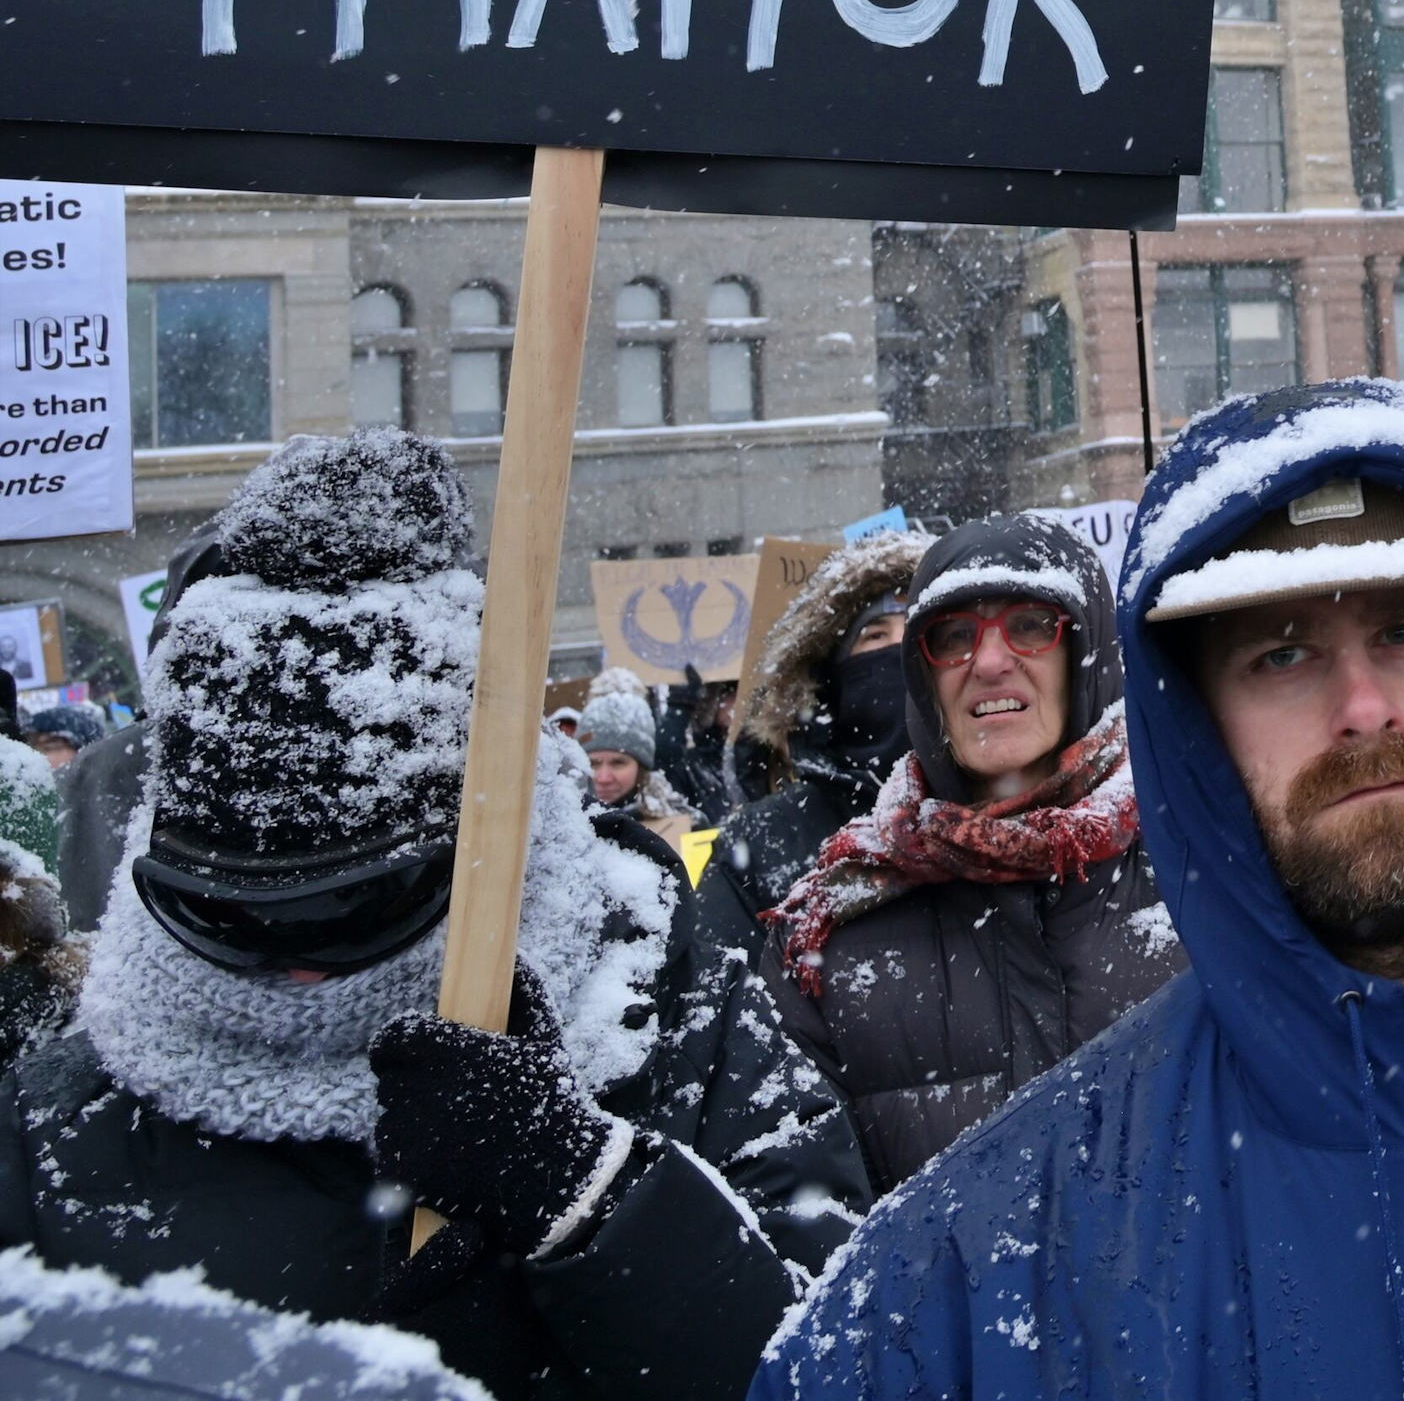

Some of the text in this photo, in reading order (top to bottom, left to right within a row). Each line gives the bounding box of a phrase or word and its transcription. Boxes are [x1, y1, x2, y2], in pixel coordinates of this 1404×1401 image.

[3, 242, 66, 272] es!
[13, 313, 111, 372] ICE!
[33, 395, 107, 417] than
[1297, 501, 1357, 519] patagonia
